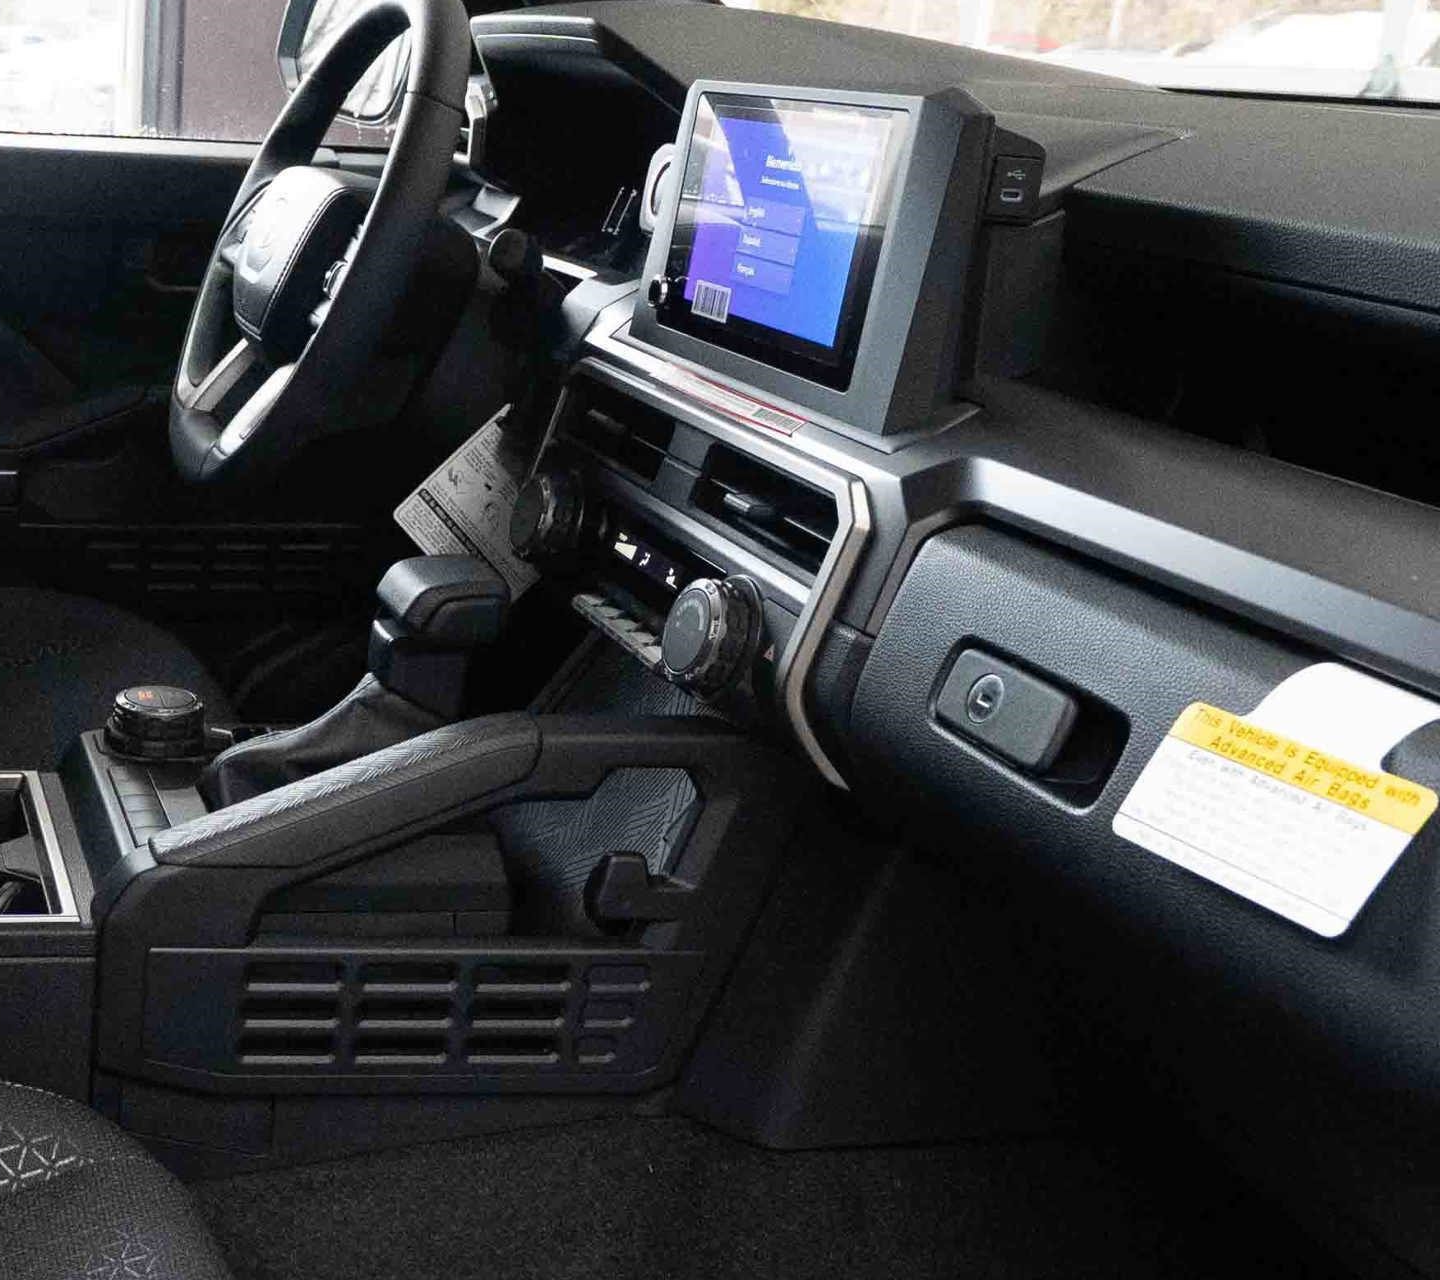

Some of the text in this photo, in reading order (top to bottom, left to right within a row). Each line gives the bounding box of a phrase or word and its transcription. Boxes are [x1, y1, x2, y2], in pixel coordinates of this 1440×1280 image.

[1209, 735, 1371, 811] Advanced Air Bags
[1228, 721, 1280, 750] Vehicle
[1304, 751, 1380, 790] Equipped
